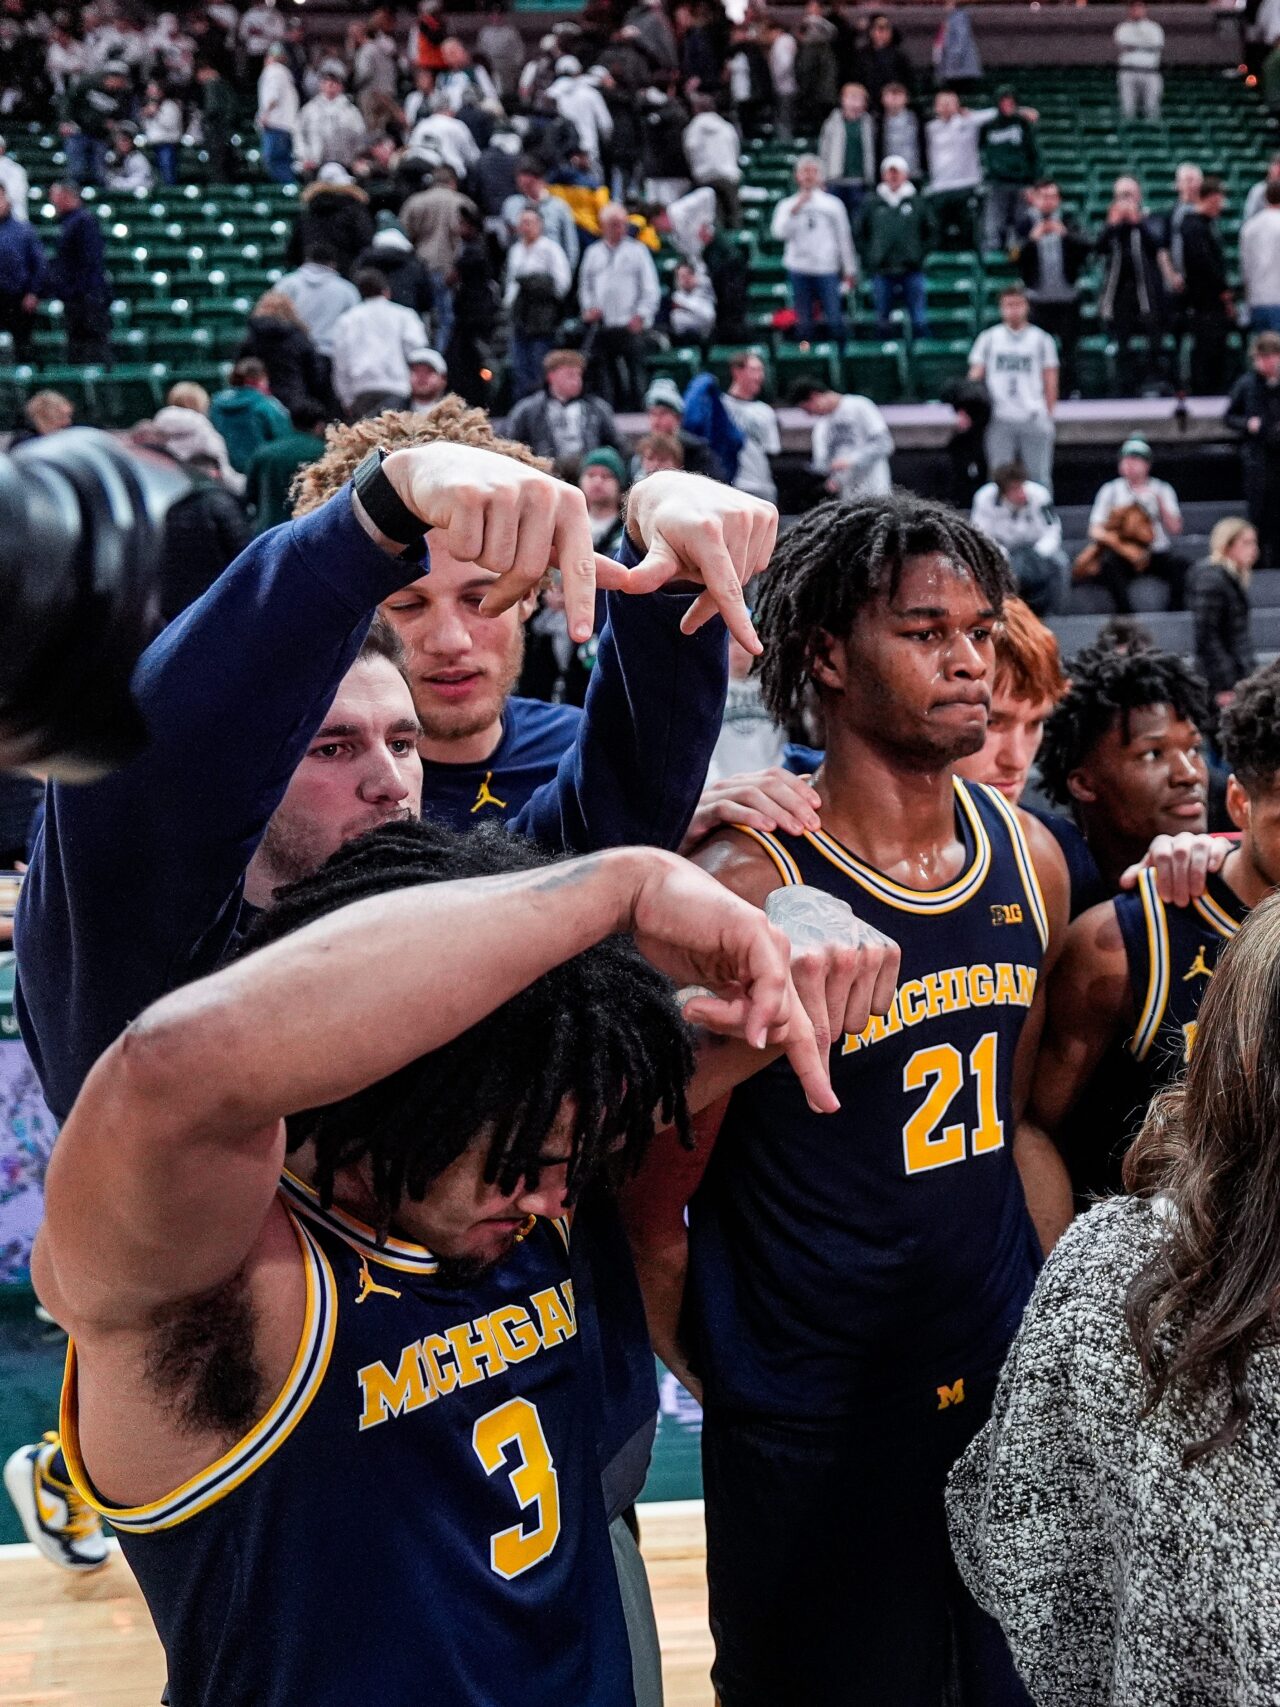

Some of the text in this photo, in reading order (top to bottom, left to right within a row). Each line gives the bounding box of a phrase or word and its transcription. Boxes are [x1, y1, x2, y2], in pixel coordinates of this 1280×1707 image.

[902, 1031, 1004, 1175] 21
[936, 1378, 965, 1410] M
[472, 1396, 560, 1580] 3
